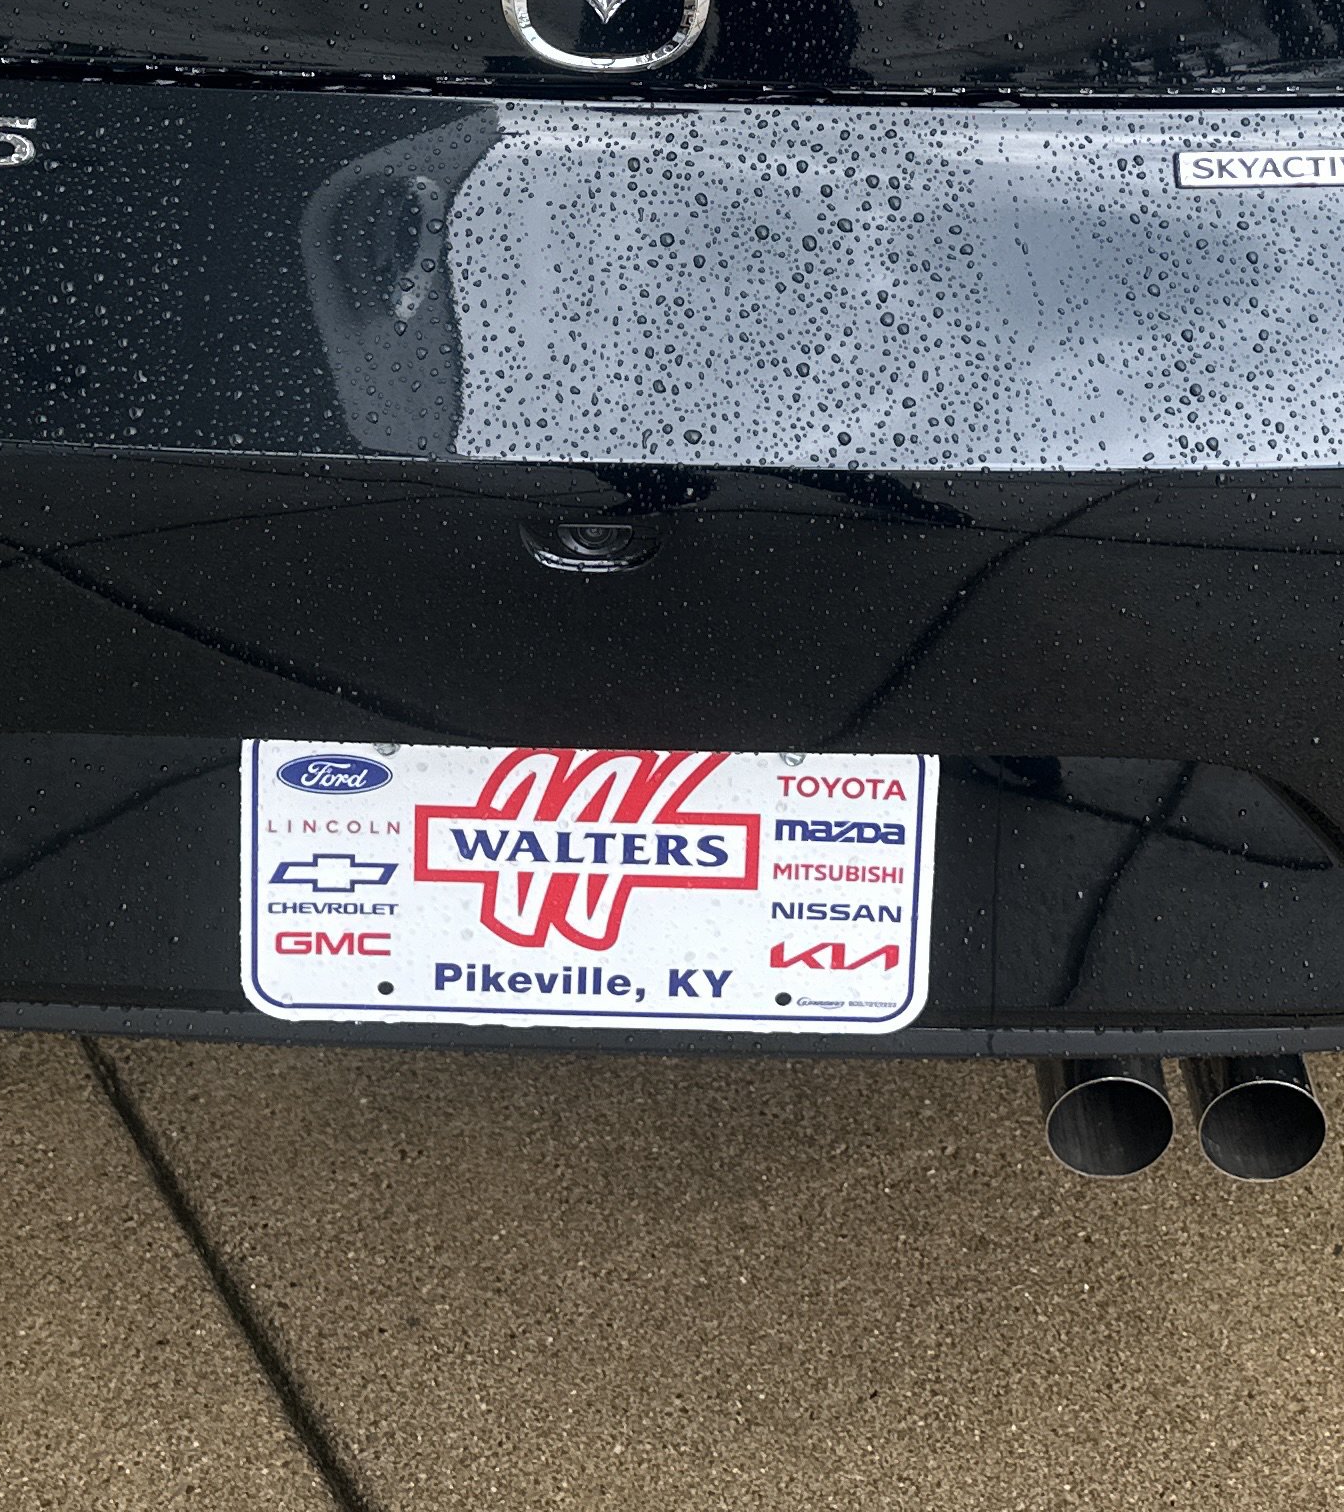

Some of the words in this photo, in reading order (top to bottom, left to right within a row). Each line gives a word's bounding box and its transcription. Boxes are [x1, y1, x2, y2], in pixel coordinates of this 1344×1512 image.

[301, 761, 369, 787] Ford
[777, 775, 907, 801] TOYOTA
[268, 819, 400, 835] LINCOLN
[450, 828, 729, 867] WALTERS
[772, 862, 904, 884] MITSUBISHI
[267, 902, 399, 915] CHEVROLET
[771, 901, 902, 923] NISSAN
[275, 932, 391, 956] GMC
[770, 941, 900, 972] KIA
[434, 962, 646, 1002] Pikeville,
[668, 968, 733, 998] KY
